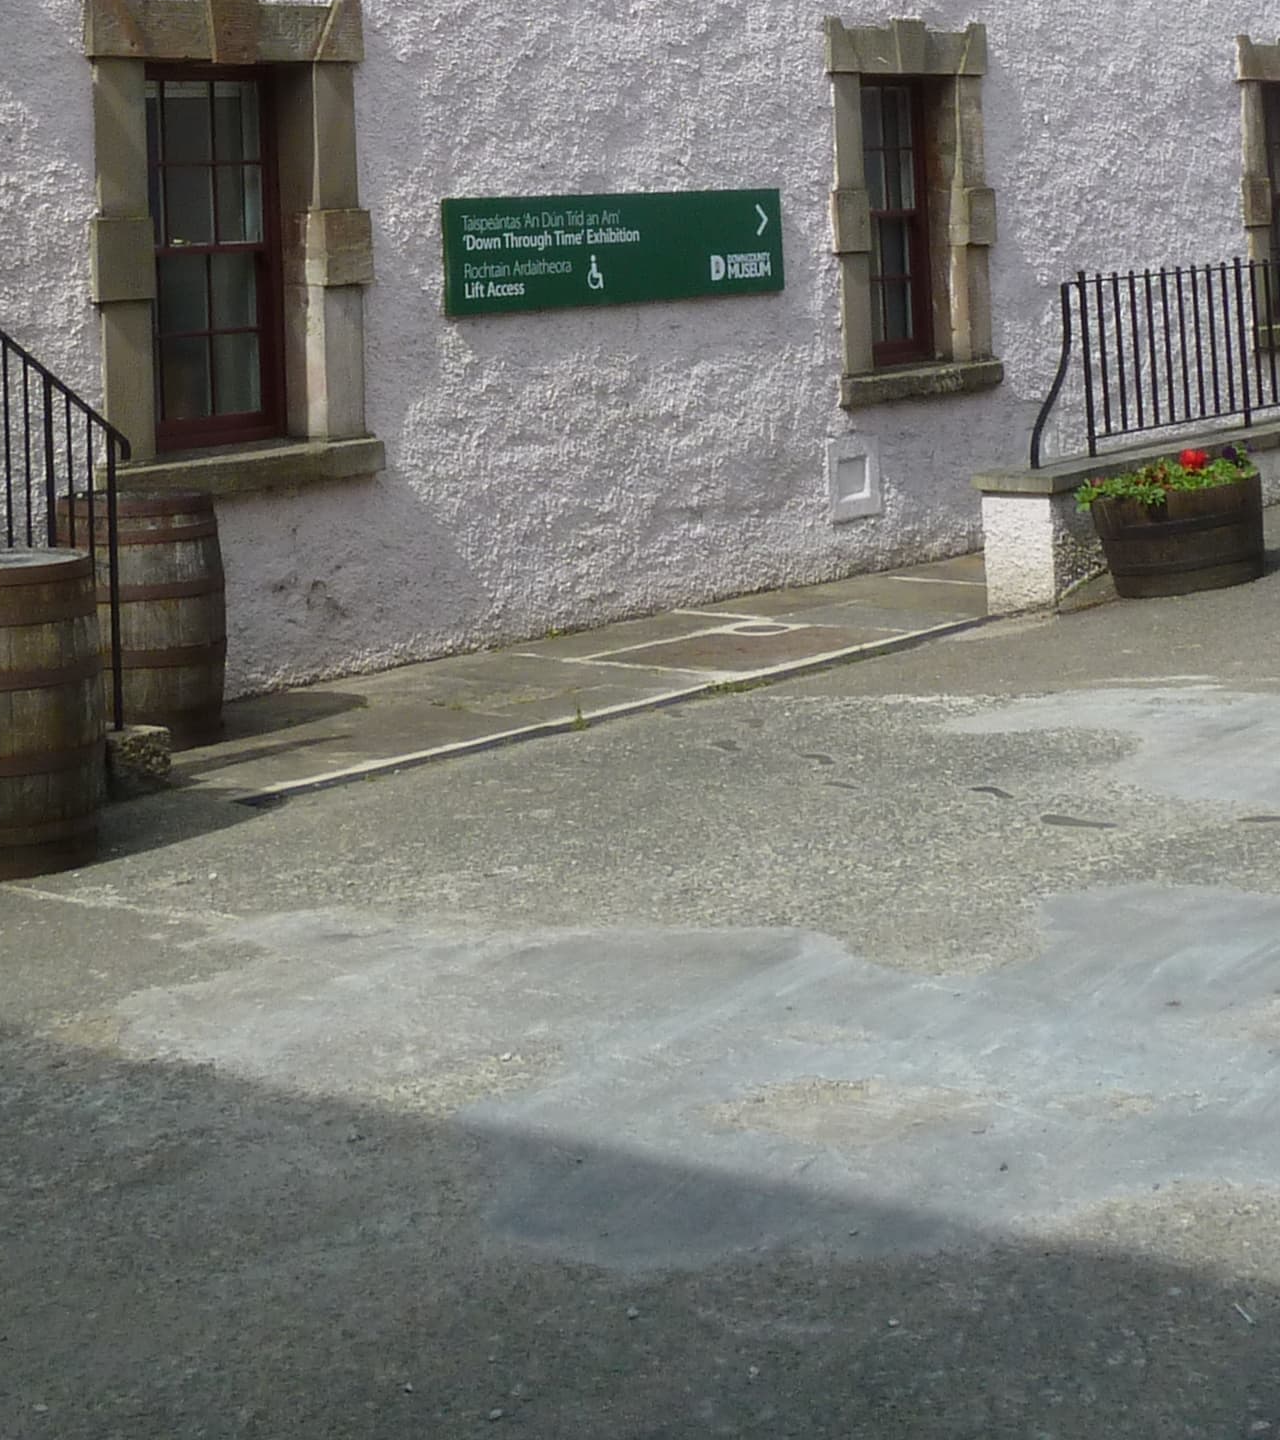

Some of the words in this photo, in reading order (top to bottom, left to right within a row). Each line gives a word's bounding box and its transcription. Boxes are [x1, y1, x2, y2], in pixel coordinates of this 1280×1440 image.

[541, 211, 564, 228] Dún
[586, 213, 600, 226] an
[502, 230, 552, 251] Through
[586, 227, 640, 245] Exhibition
[464, 261, 510, 279] Rochtain
[512, 258, 572, 276] Ardaitheora
[727, 261, 772, 279] MUSEUM
[464, 281, 485, 299] Lift
[486, 281, 525, 298] Access
